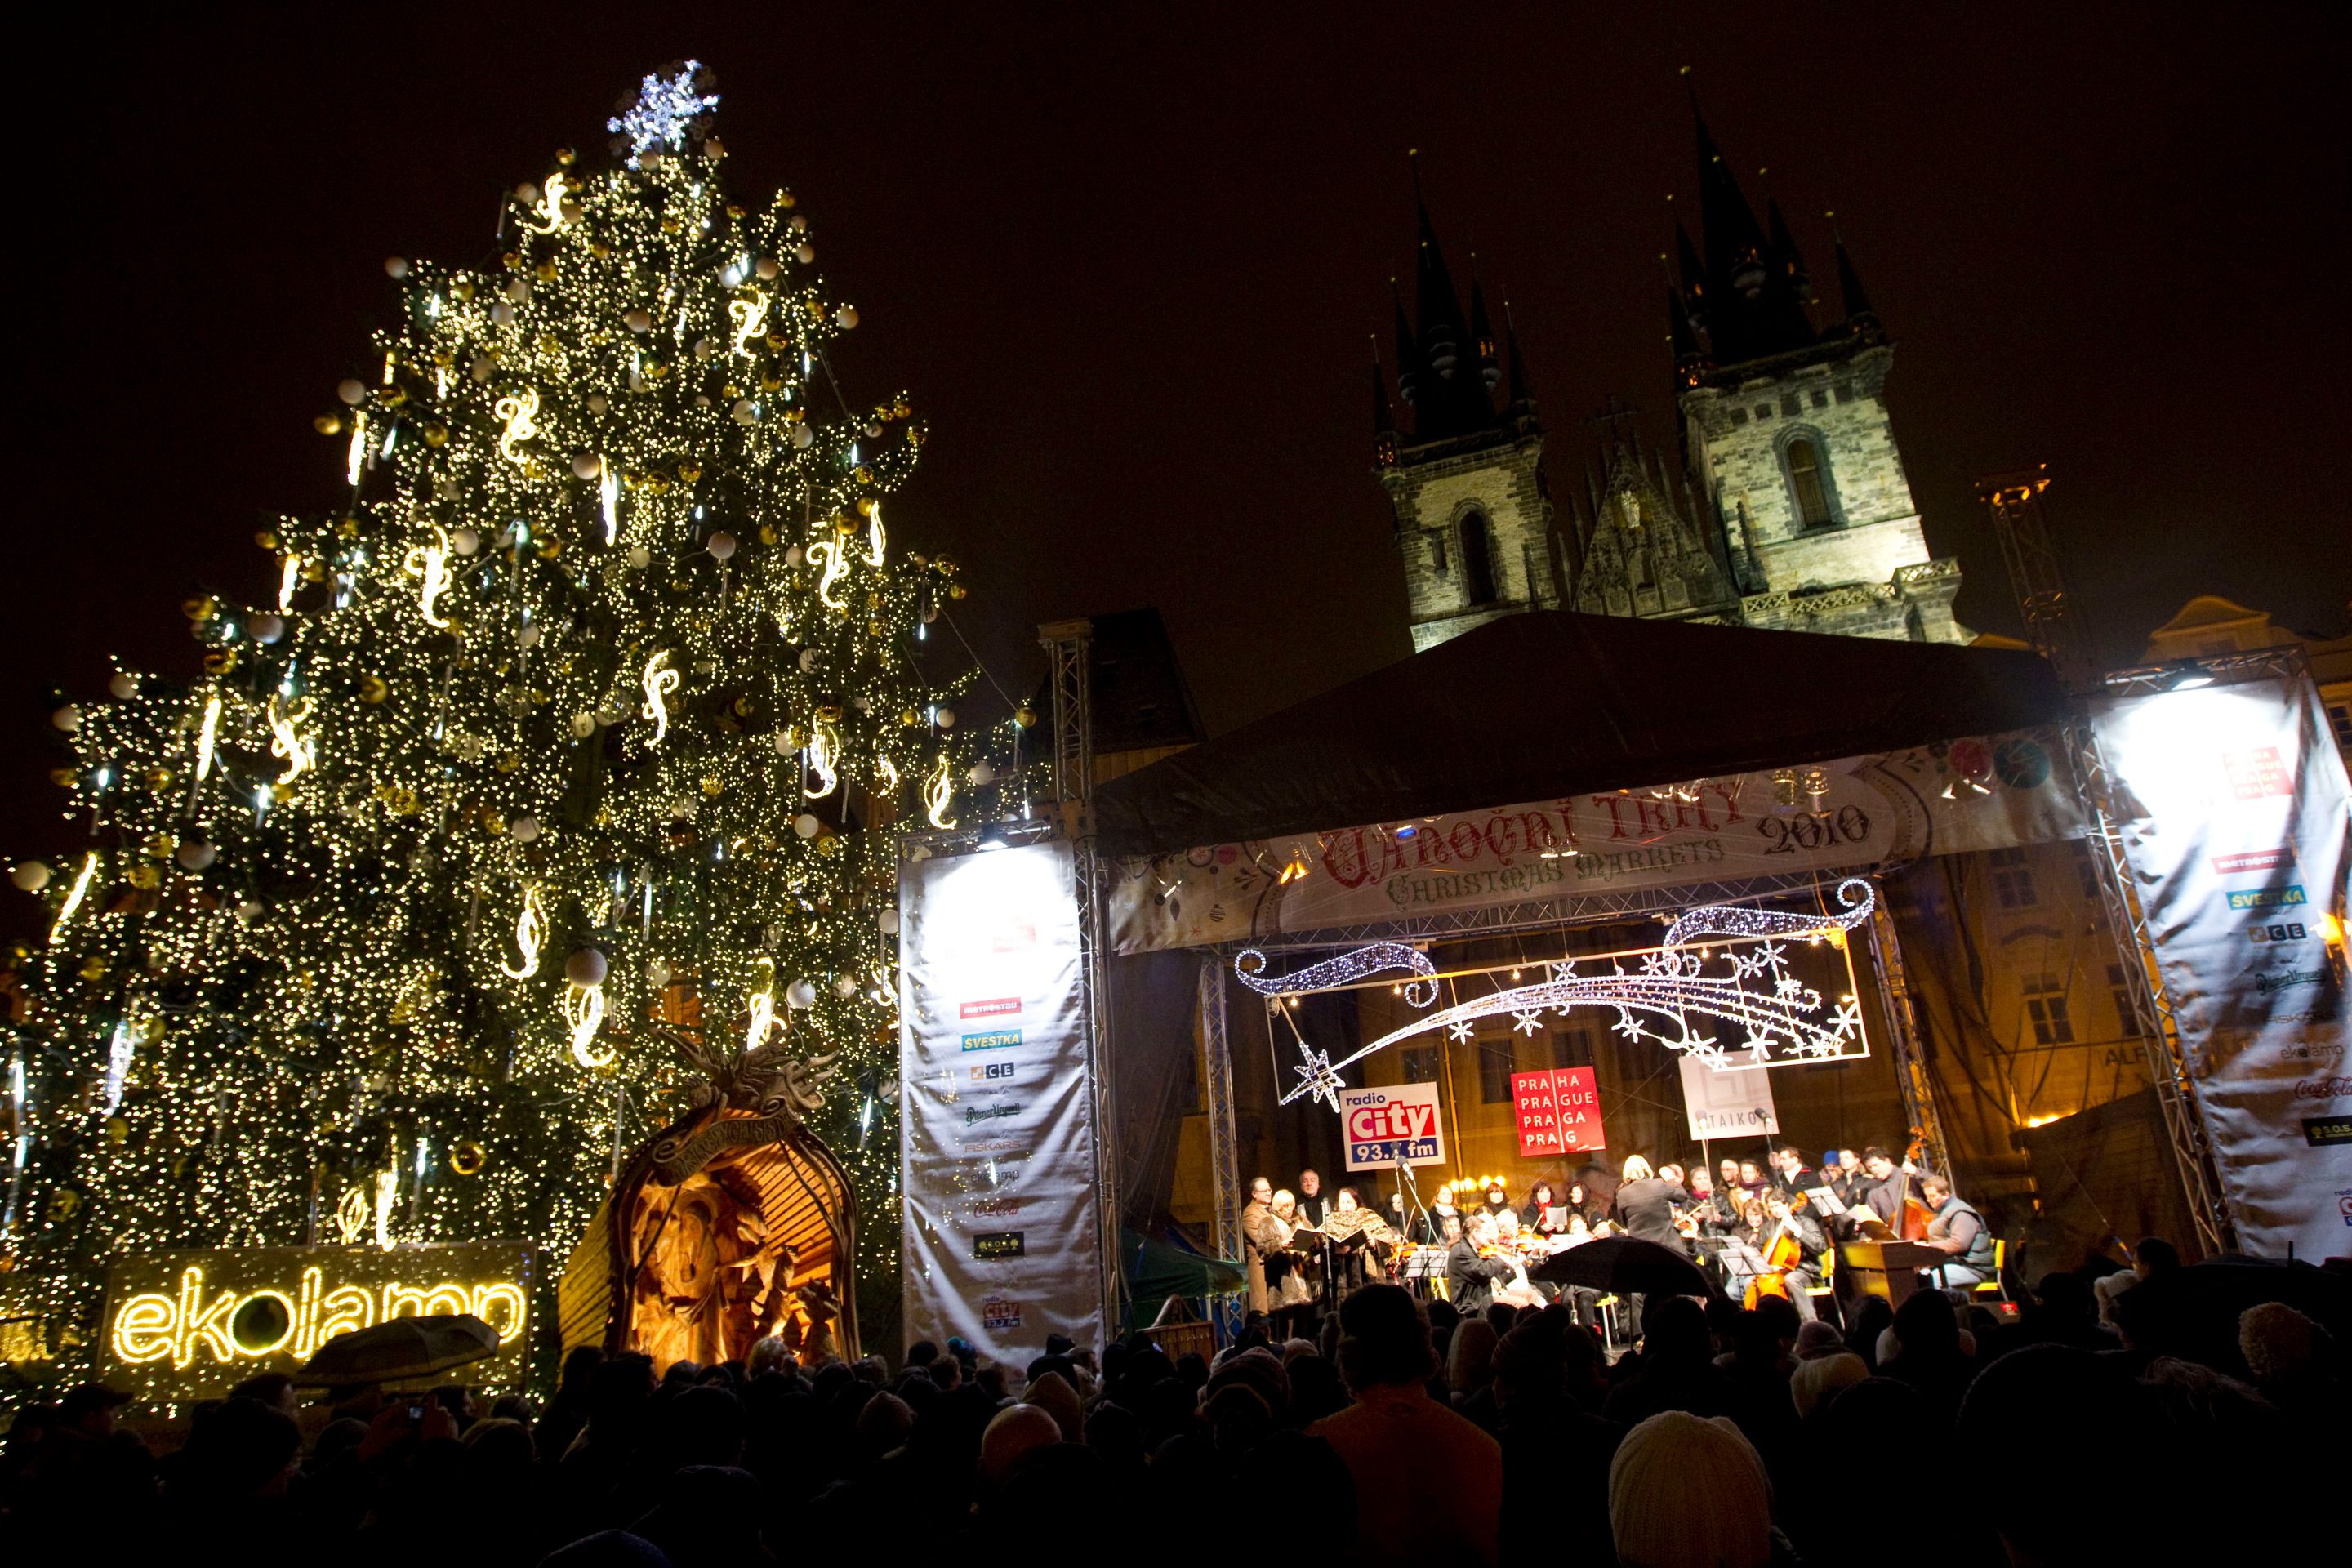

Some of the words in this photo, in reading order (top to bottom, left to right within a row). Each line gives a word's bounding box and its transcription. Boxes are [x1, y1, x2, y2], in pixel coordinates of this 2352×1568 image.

[1755, 804, 1871, 854] 2010
[1388, 862, 1564, 912] CHRISTMAS
[1576, 838, 1724, 883] MARKETS
[2269, 1012, 2335, 1024] ISKARS
[1346, 1093, 1386, 1106] radio
[1708, 1111, 1757, 1128] TAIKO
[964, 1140, 1021, 1152] FISKARS
[1356, 1143, 1402, 1161] 93.
[1407, 1142, 1434, 1157] fm
[971, 1169, 1019, 1183] ekoamp
[112, 1266, 528, 1370] ekolamp
